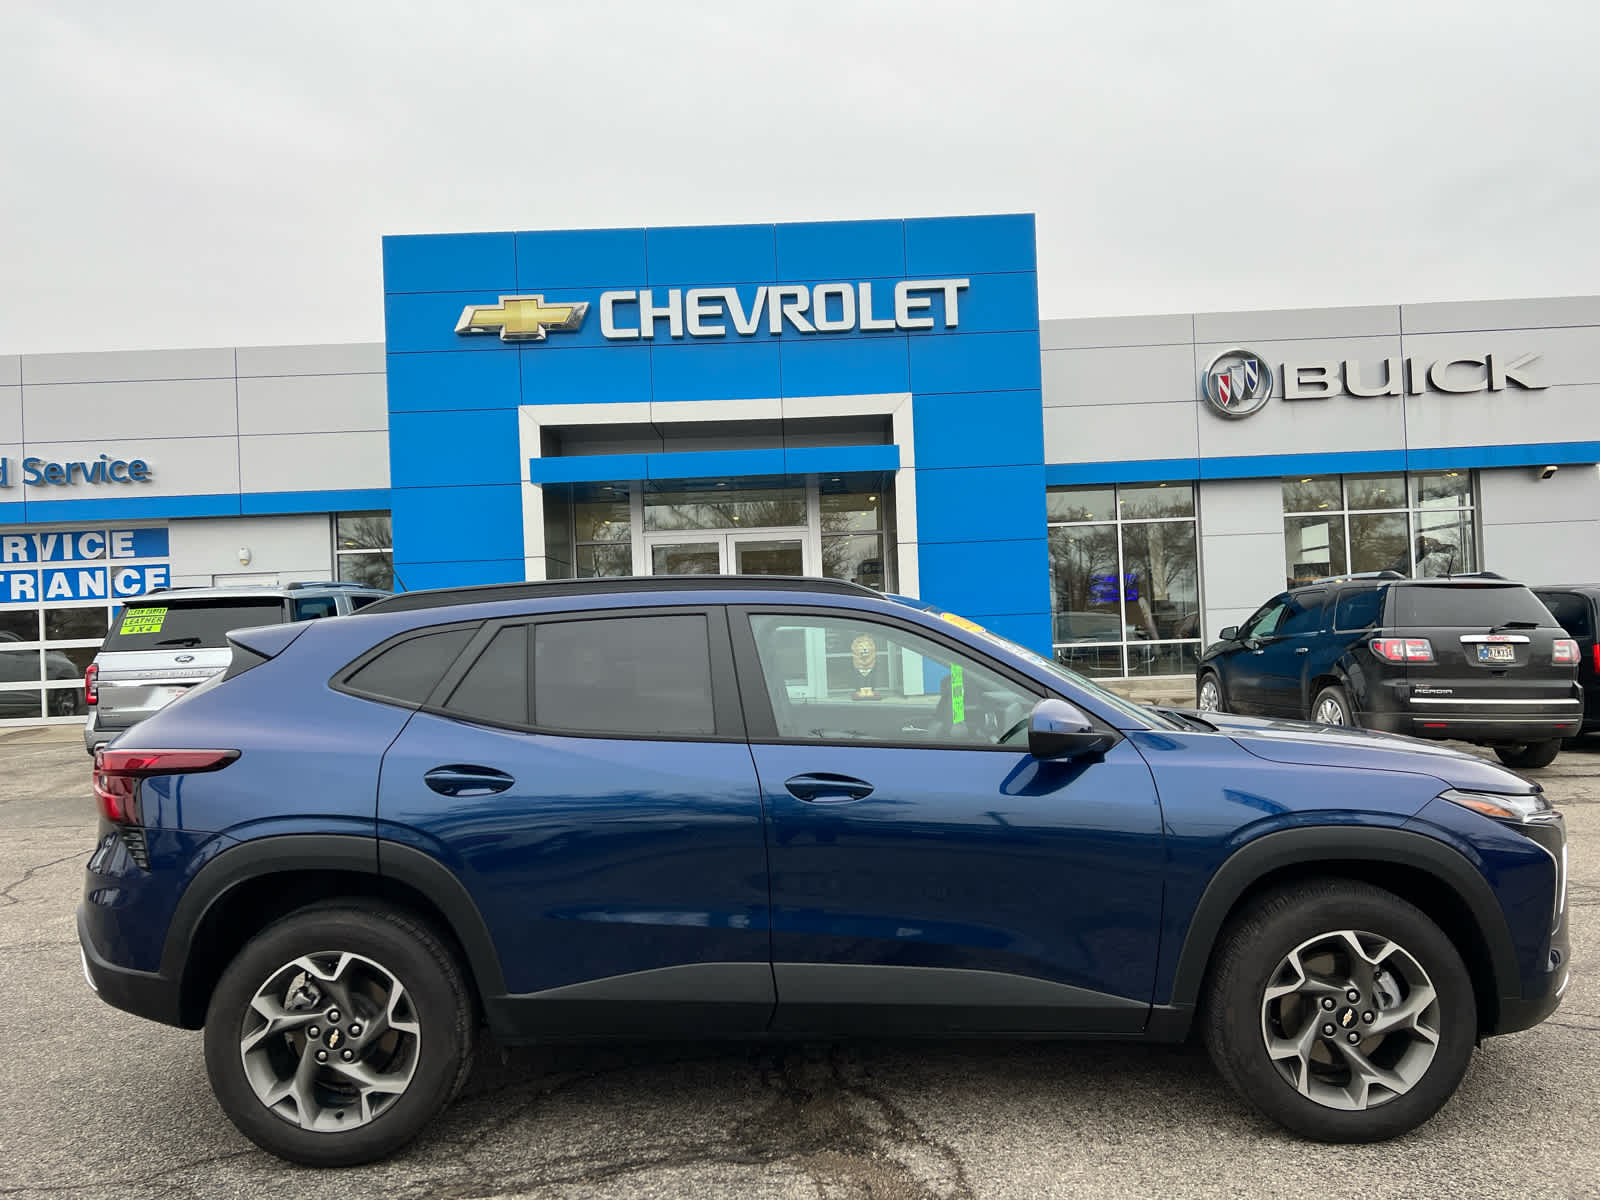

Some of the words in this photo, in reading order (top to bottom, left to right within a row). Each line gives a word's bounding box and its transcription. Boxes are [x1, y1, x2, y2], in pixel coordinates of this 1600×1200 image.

[599, 278, 970, 340] CHEVROLET
[1280, 352, 1552, 400] BUICK
[22, 453, 151, 486] Service
[0, 567, 167, 601] RANCE
[124, 616, 163, 625] LEATHER
